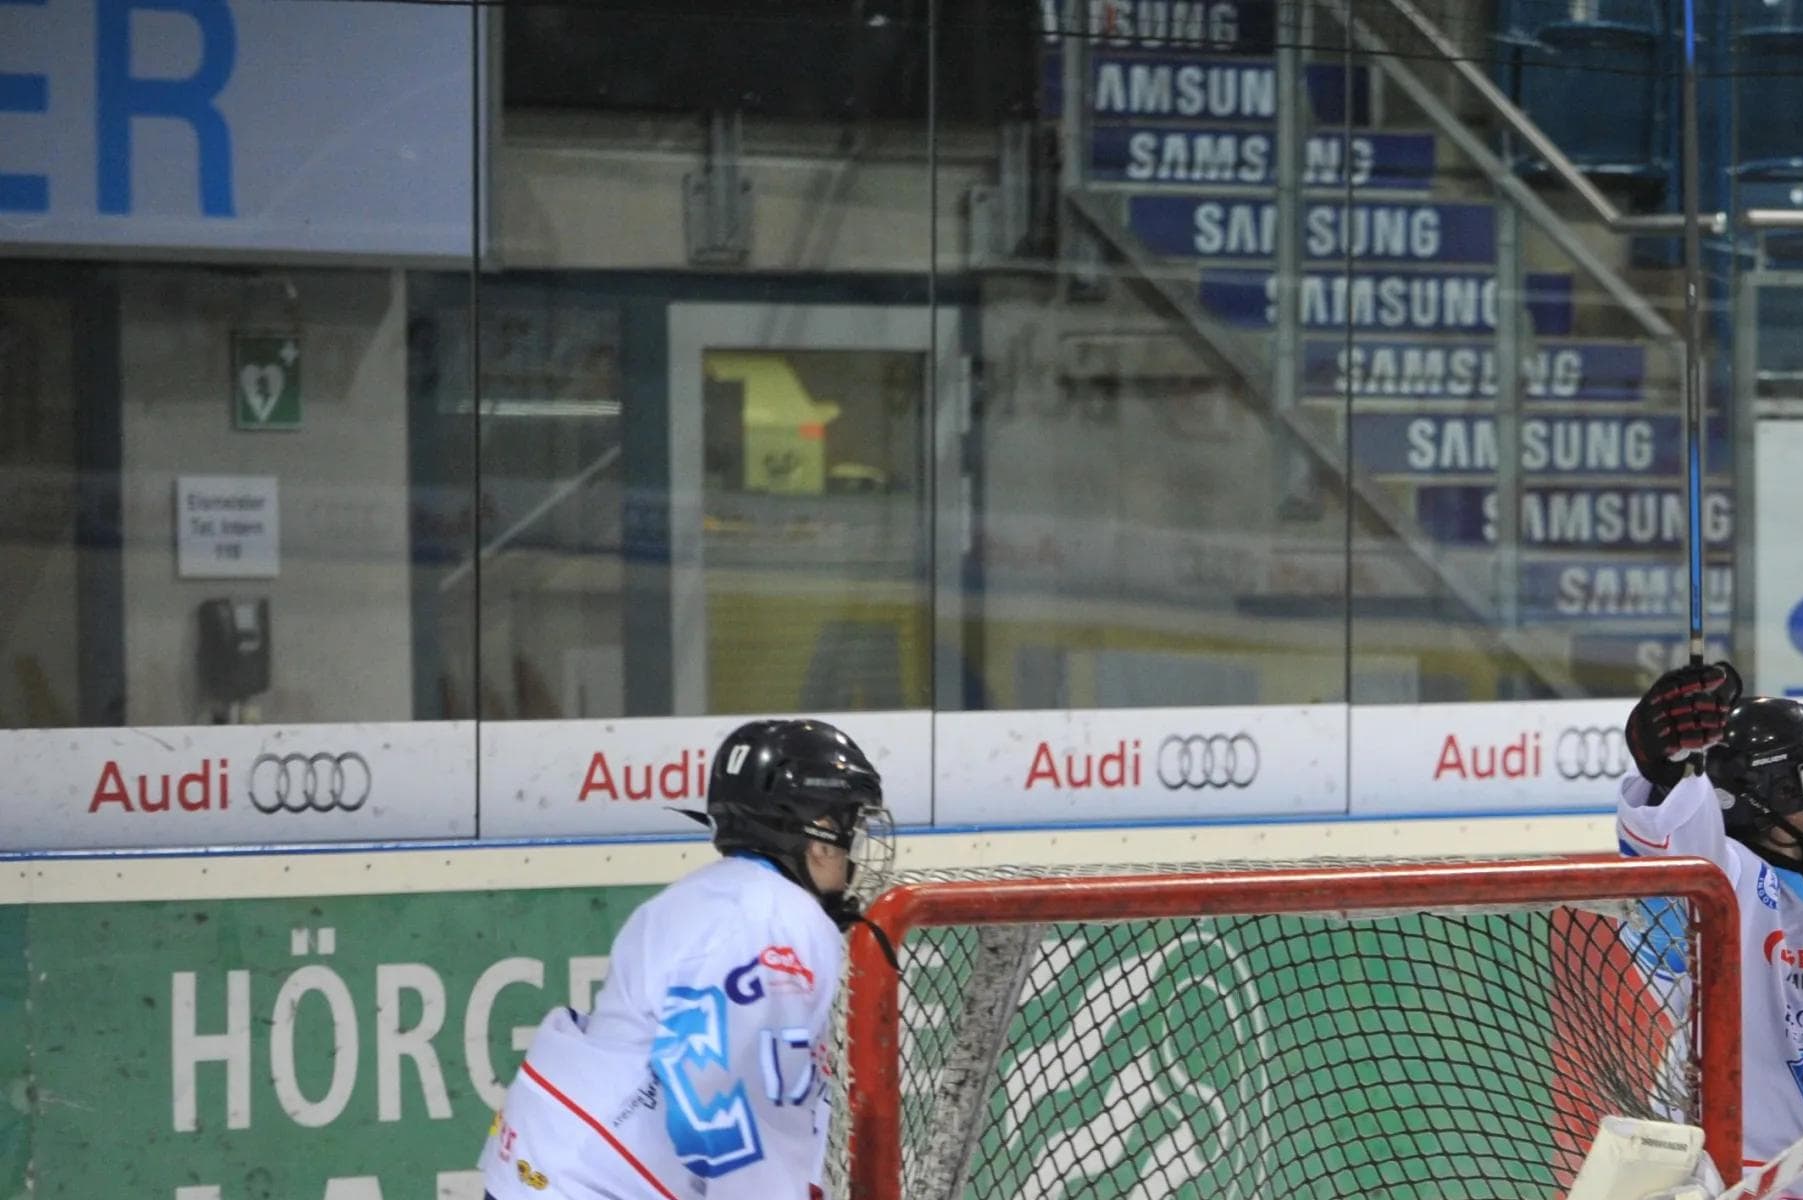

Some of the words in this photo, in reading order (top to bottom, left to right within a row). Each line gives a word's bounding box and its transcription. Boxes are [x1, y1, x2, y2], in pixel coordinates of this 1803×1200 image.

[577, 748, 706, 802] Audi
[1024, 740, 1142, 790] Audi
[1433, 732, 1542, 780] Audi
[88, 758, 231, 813] Audi
